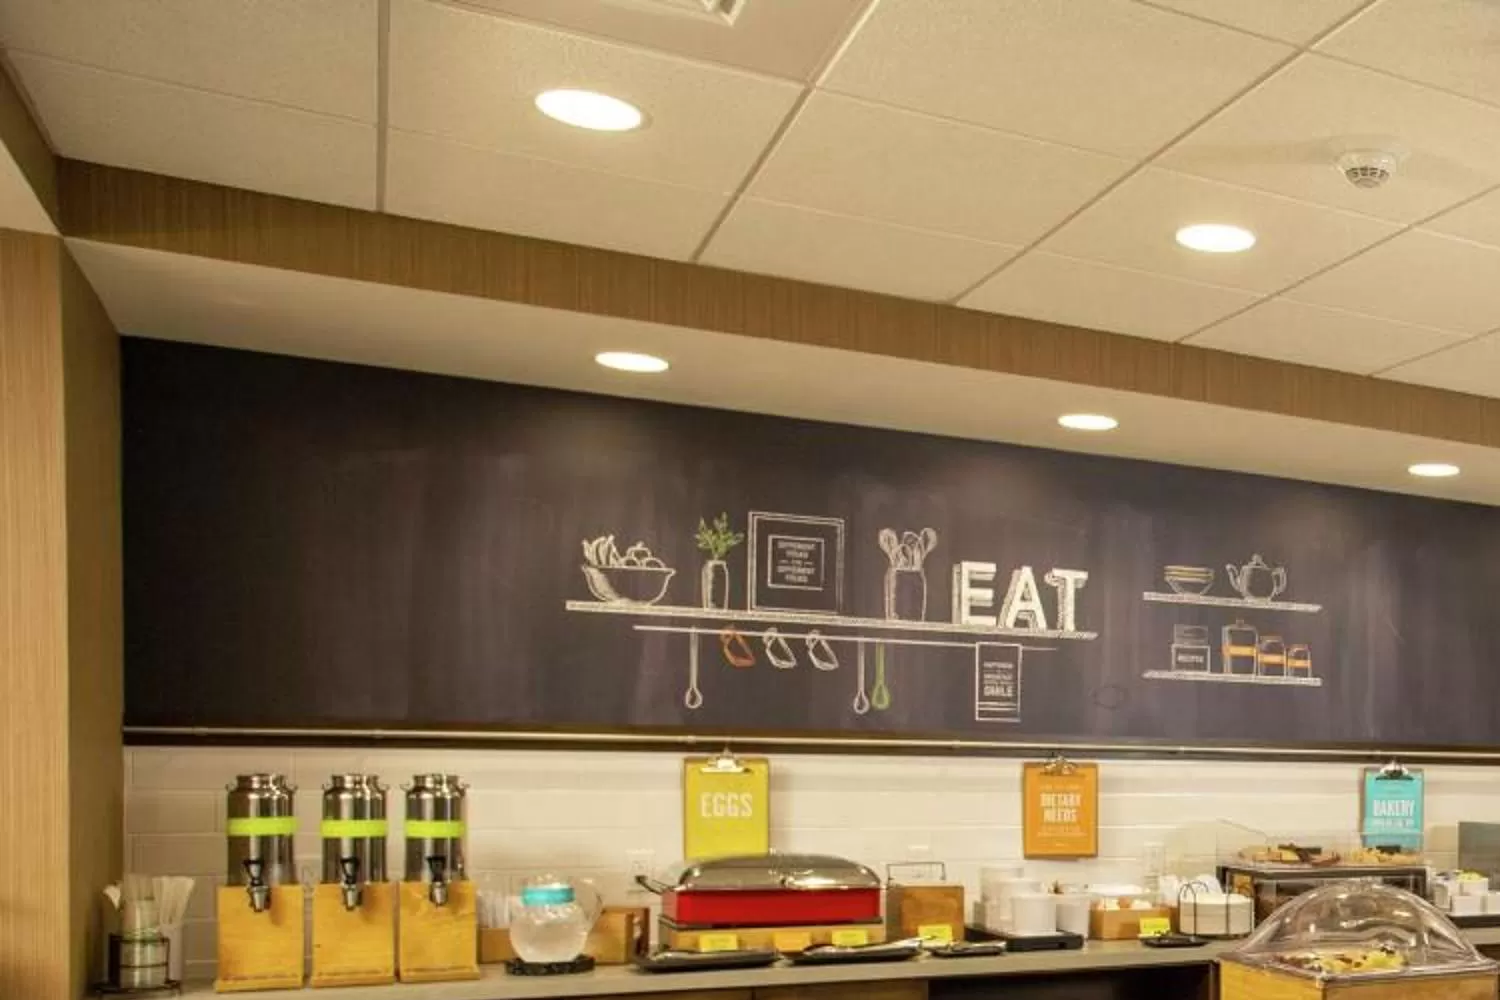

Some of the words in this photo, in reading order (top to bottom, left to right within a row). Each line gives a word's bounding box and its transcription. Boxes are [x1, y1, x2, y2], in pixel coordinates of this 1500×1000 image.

[952, 560, 1088, 632] EAT
[701, 791, 753, 817] EGGS
[1040, 792, 1081, 808] DIETARY
[1373, 799, 1416, 817] BAKERY
[1043, 808, 1077, 823] NEEDS
